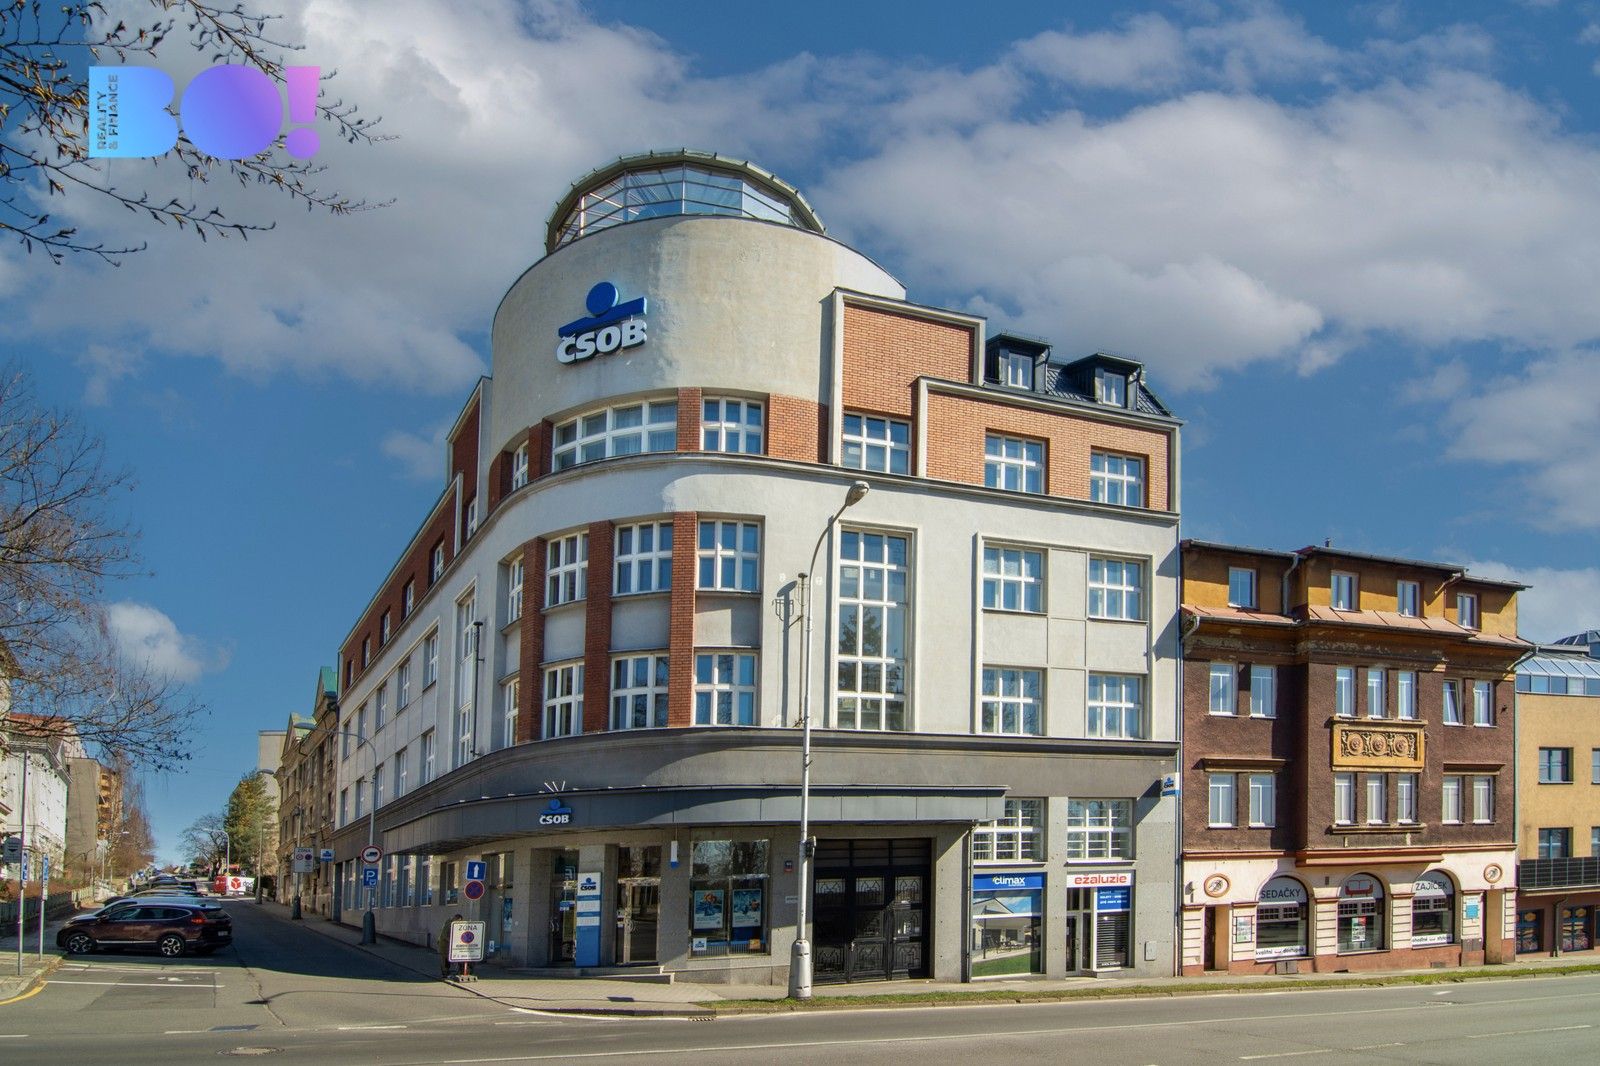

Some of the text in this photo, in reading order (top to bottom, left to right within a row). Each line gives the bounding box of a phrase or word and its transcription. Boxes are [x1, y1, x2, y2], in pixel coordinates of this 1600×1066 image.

[556, 319, 648, 365] ČSOB
[539, 814, 570, 825] ČSOB
[994, 876, 1026, 885] climax
[1074, 874, 1127, 885] ežaluzie
[1415, 879, 1448, 891] ZAJÍČEK
[1260, 887, 1301, 899] SEDAČKY
